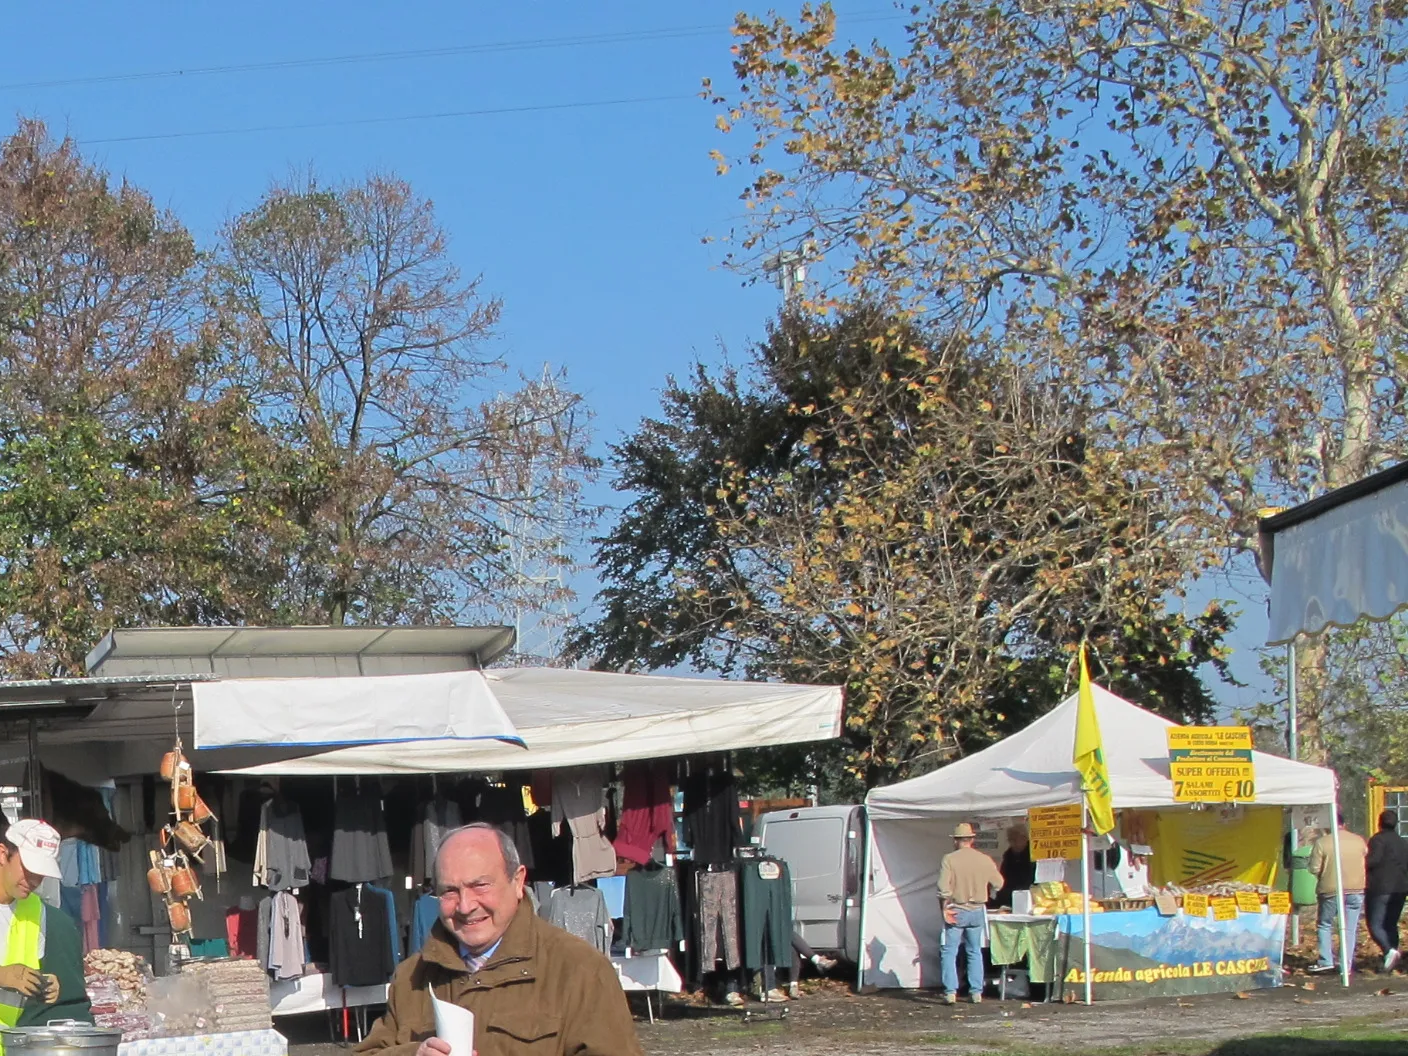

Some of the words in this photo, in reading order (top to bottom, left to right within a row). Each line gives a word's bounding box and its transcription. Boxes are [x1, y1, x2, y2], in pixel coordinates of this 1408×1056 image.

[1176, 767, 1203, 777] SUPER
[1205, 767, 1240, 777] OFFERTA
[1174, 781, 1184, 797] 7
[1033, 840, 1039, 849] 7
[1135, 964, 1190, 984] agricola
[1192, 962, 1213, 977] LE
